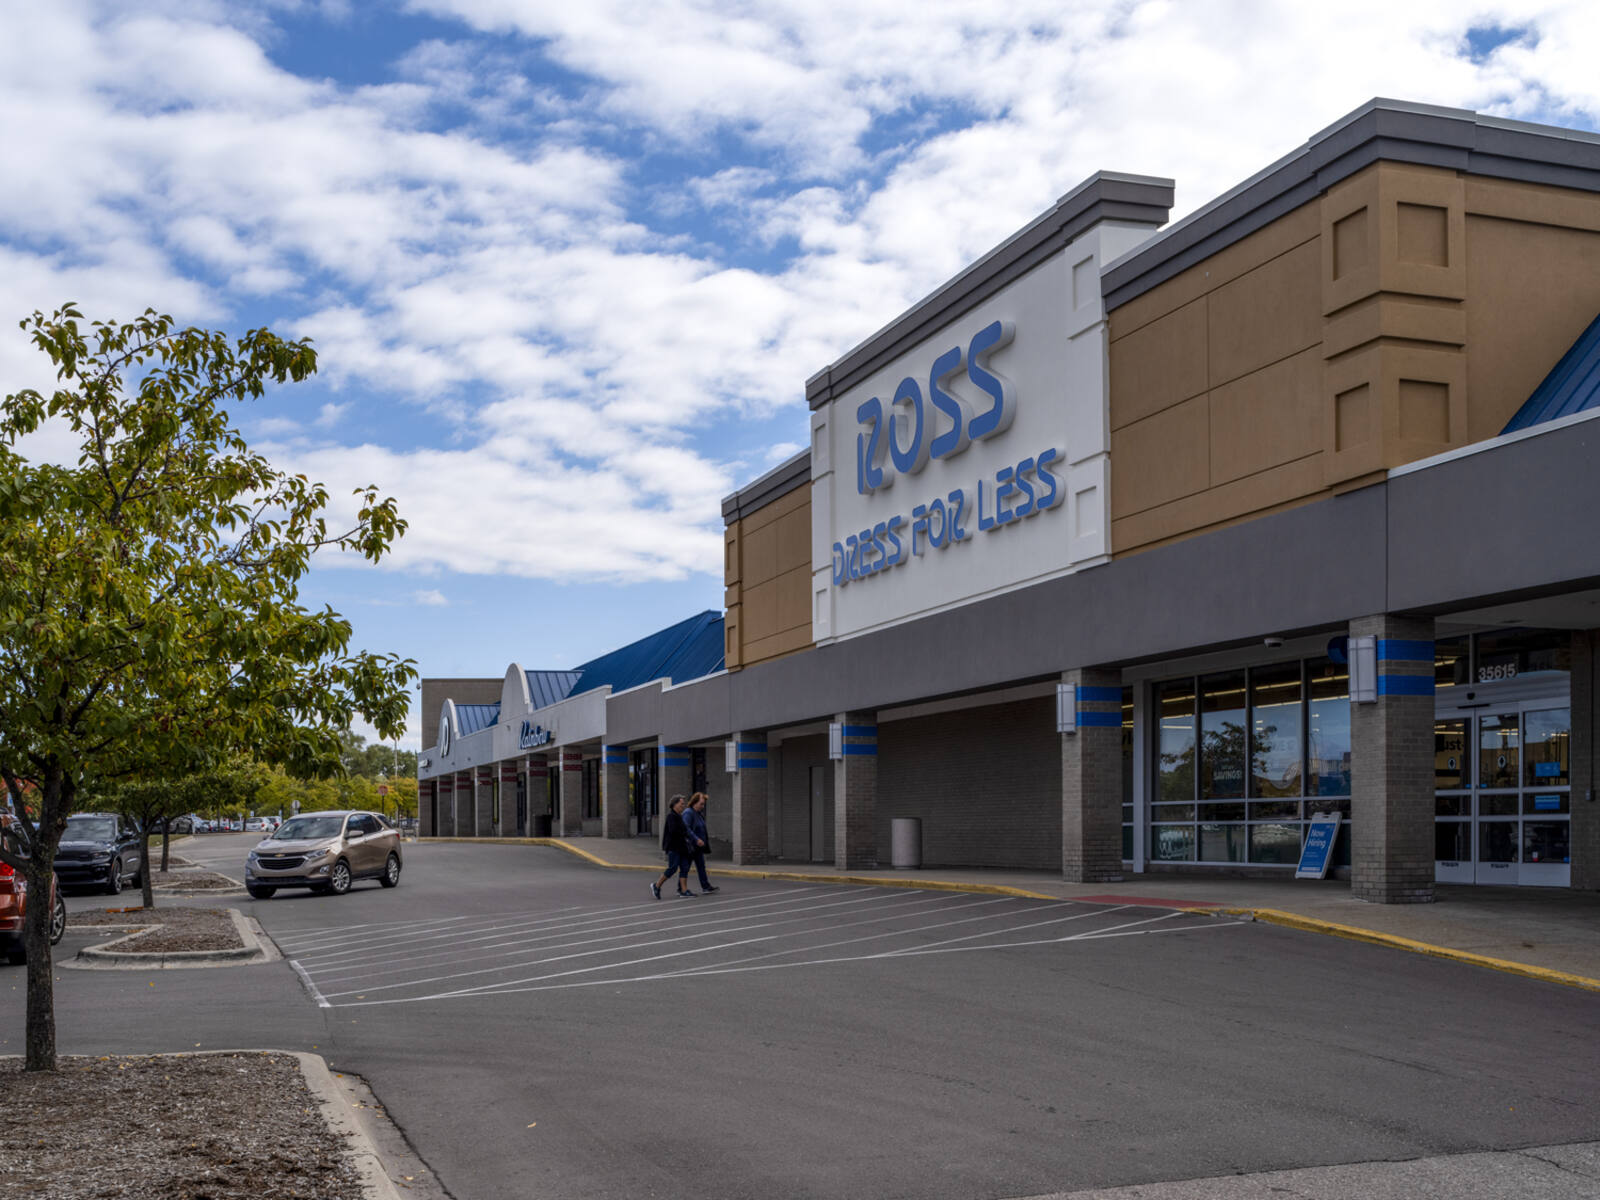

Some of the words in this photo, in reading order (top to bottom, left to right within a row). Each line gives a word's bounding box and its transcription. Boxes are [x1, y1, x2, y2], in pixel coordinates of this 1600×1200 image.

[856, 318, 1011, 495] ROSS
[832, 514, 906, 586] DRESS
[911, 488, 969, 557] FOR
[977, 447, 1062, 532] LESS
[1478, 662, 1517, 681] 35615
[1307, 838, 1327, 849] Hiring
